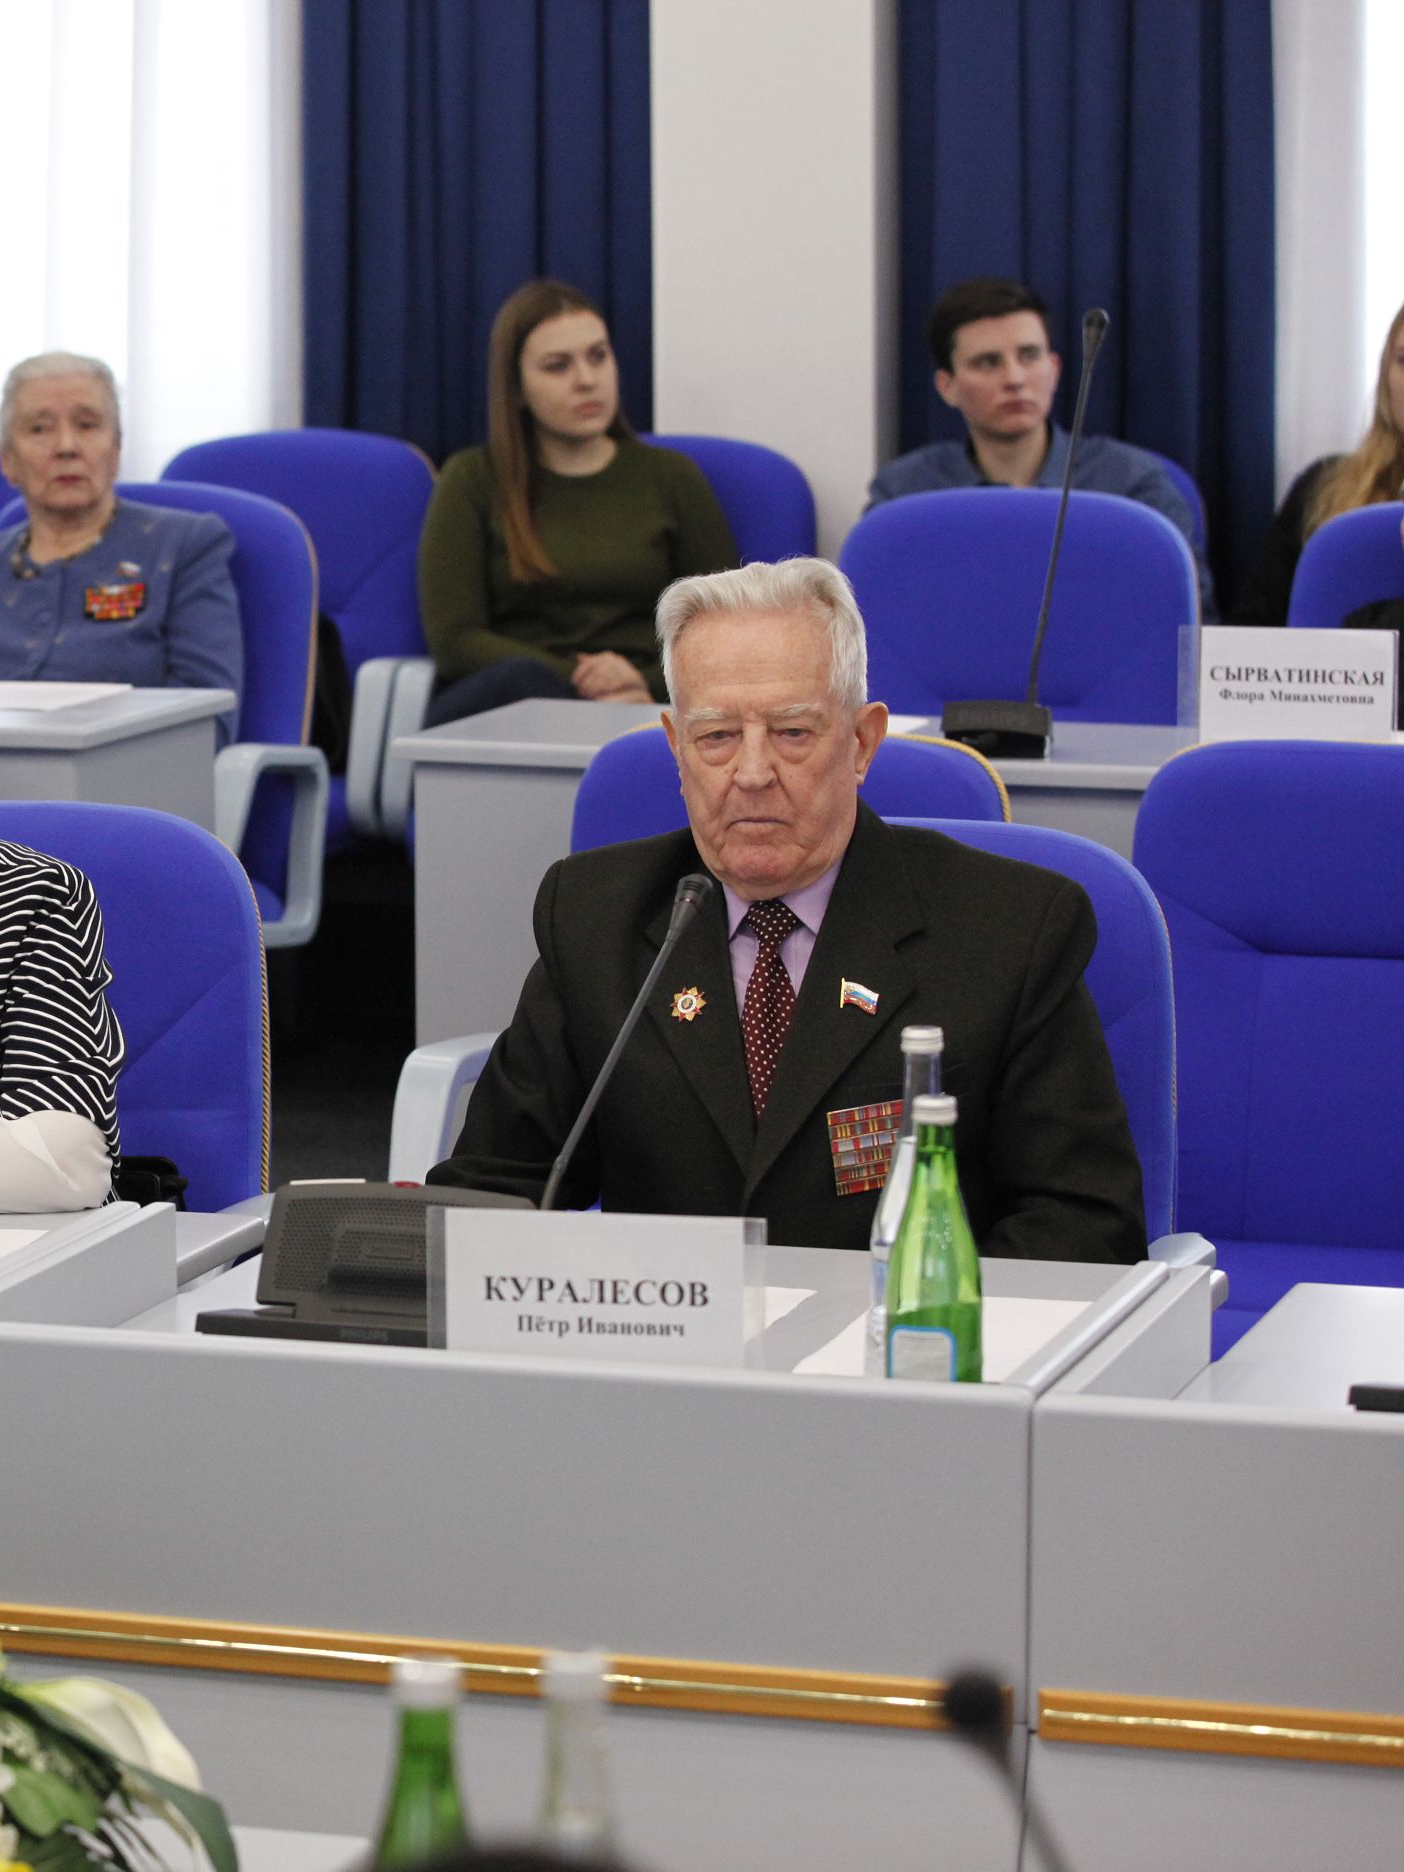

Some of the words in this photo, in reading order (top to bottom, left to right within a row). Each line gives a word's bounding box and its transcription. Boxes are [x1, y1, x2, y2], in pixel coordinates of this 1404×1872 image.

[1209, 665, 1385, 686] СЫРВАТИНСКАЯ
[1219, 688, 1265, 703] Флора
[1270, 689, 1375, 704] Минахметовна
[484, 1275, 709, 1307] КУРАЛЕСОВ
[517, 1314, 570, 1338] Пётр
[578, 1316, 686, 1337] Иванович
